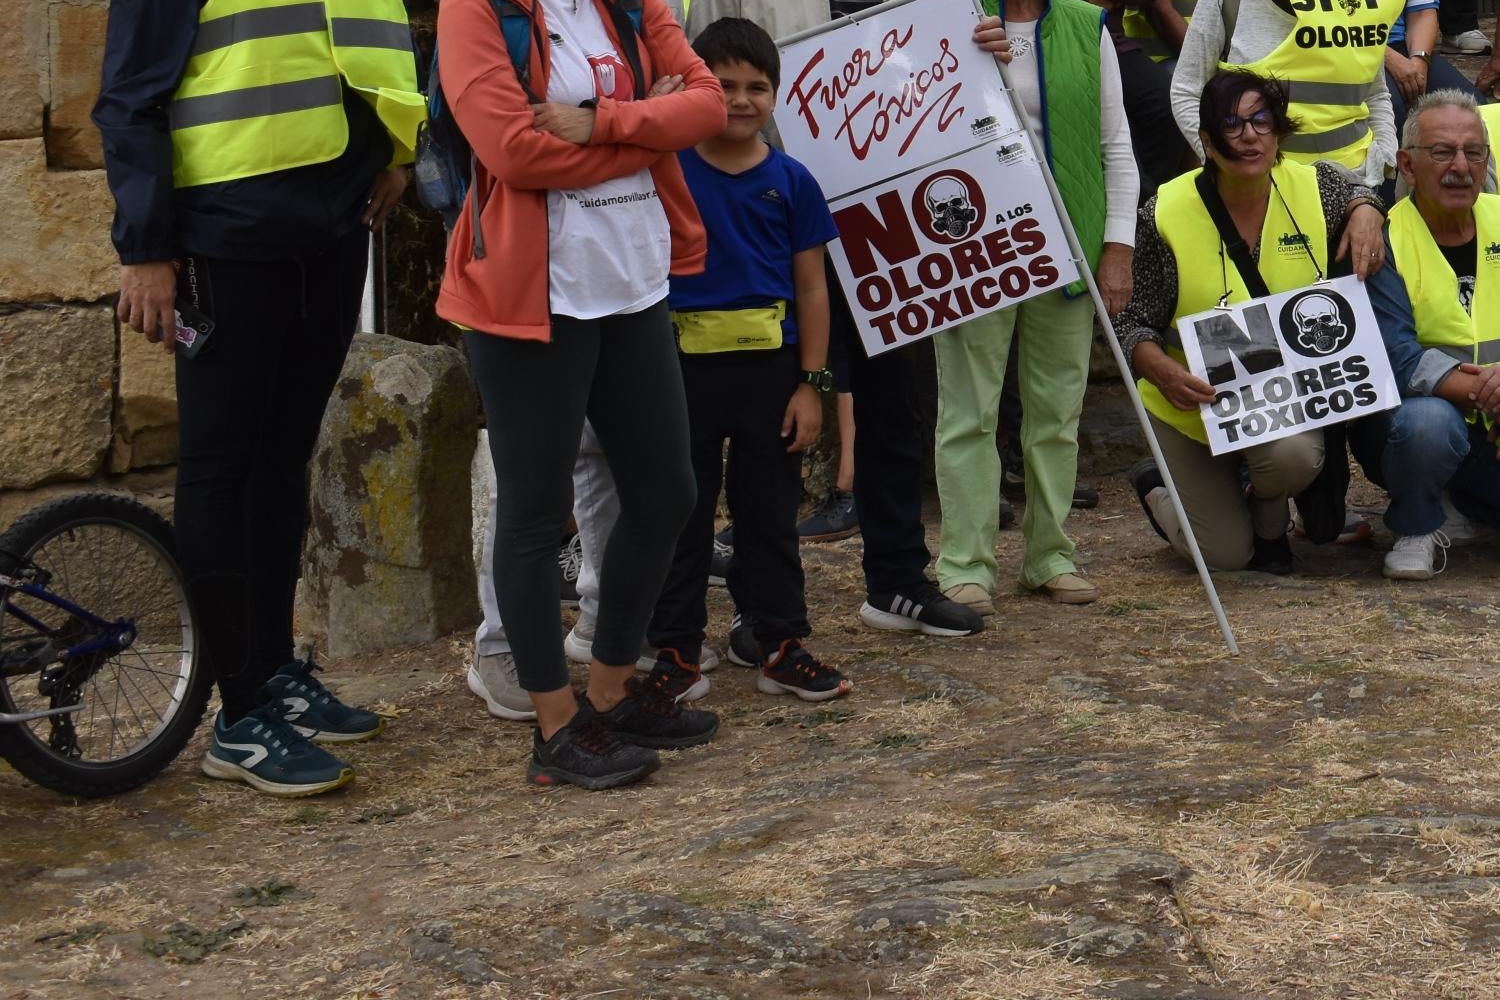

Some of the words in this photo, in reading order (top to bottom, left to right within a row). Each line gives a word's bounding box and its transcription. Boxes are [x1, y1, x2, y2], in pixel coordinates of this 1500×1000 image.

[786, 24, 914, 140] Fuera
[1295, 23, 1389, 49] OLORES
[832, 168, 987, 279] NO
[994, 212, 1006, 225] A
[1007, 203, 1033, 221] LOS
[856, 218, 1047, 313] OLORES
[870, 254, 1060, 346] TÓXICOS
[1194, 288, 1357, 386] NO
[1211, 354, 1370, 418] OLORES
